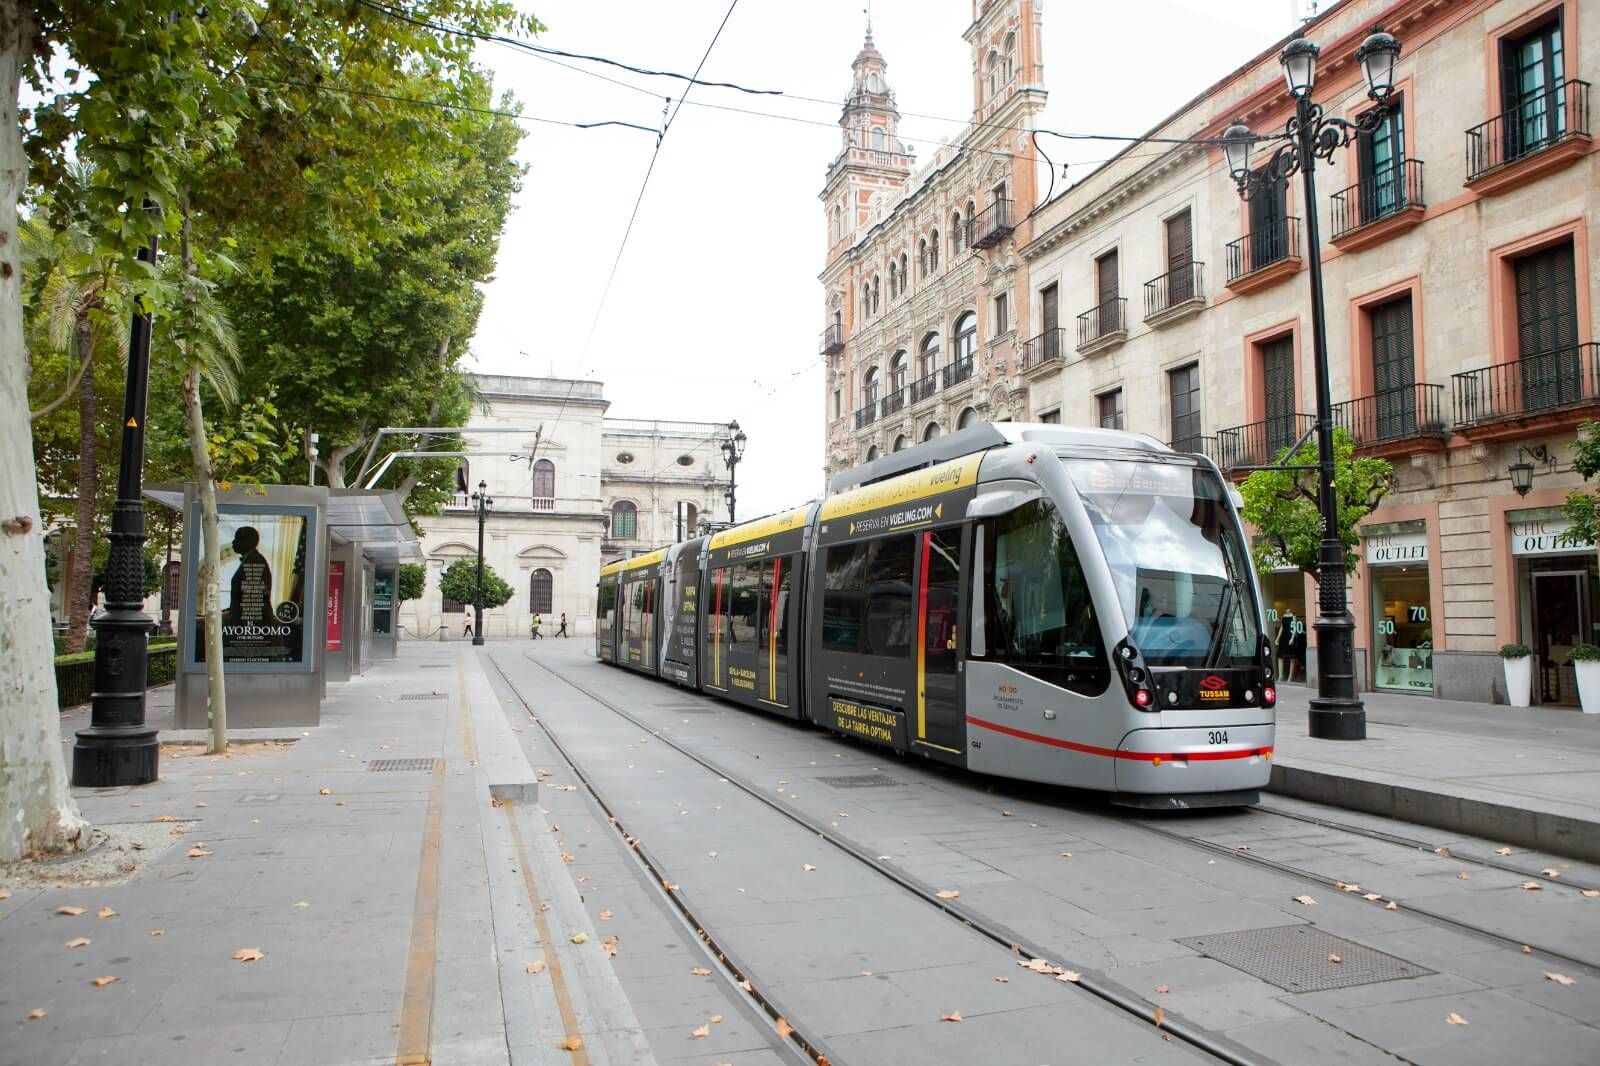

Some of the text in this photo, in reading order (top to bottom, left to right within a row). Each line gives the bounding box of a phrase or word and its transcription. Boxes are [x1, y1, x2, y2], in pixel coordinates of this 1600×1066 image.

[930, 467, 962, 486] vueling
[856, 506, 932, 532] RESERVA EN VUELING.COM
[1524, 536, 1585, 551] OUTLE
[1376, 546, 1427, 560] OUTLET
[222, 626, 291, 635] AYORDOMO
[832, 701, 896, 727] DESCUBRE LAS VENTAJAS
[838, 716, 892, 742] DE LA TARIFA OPTIMA
[1208, 731, 1228, 745] 304
